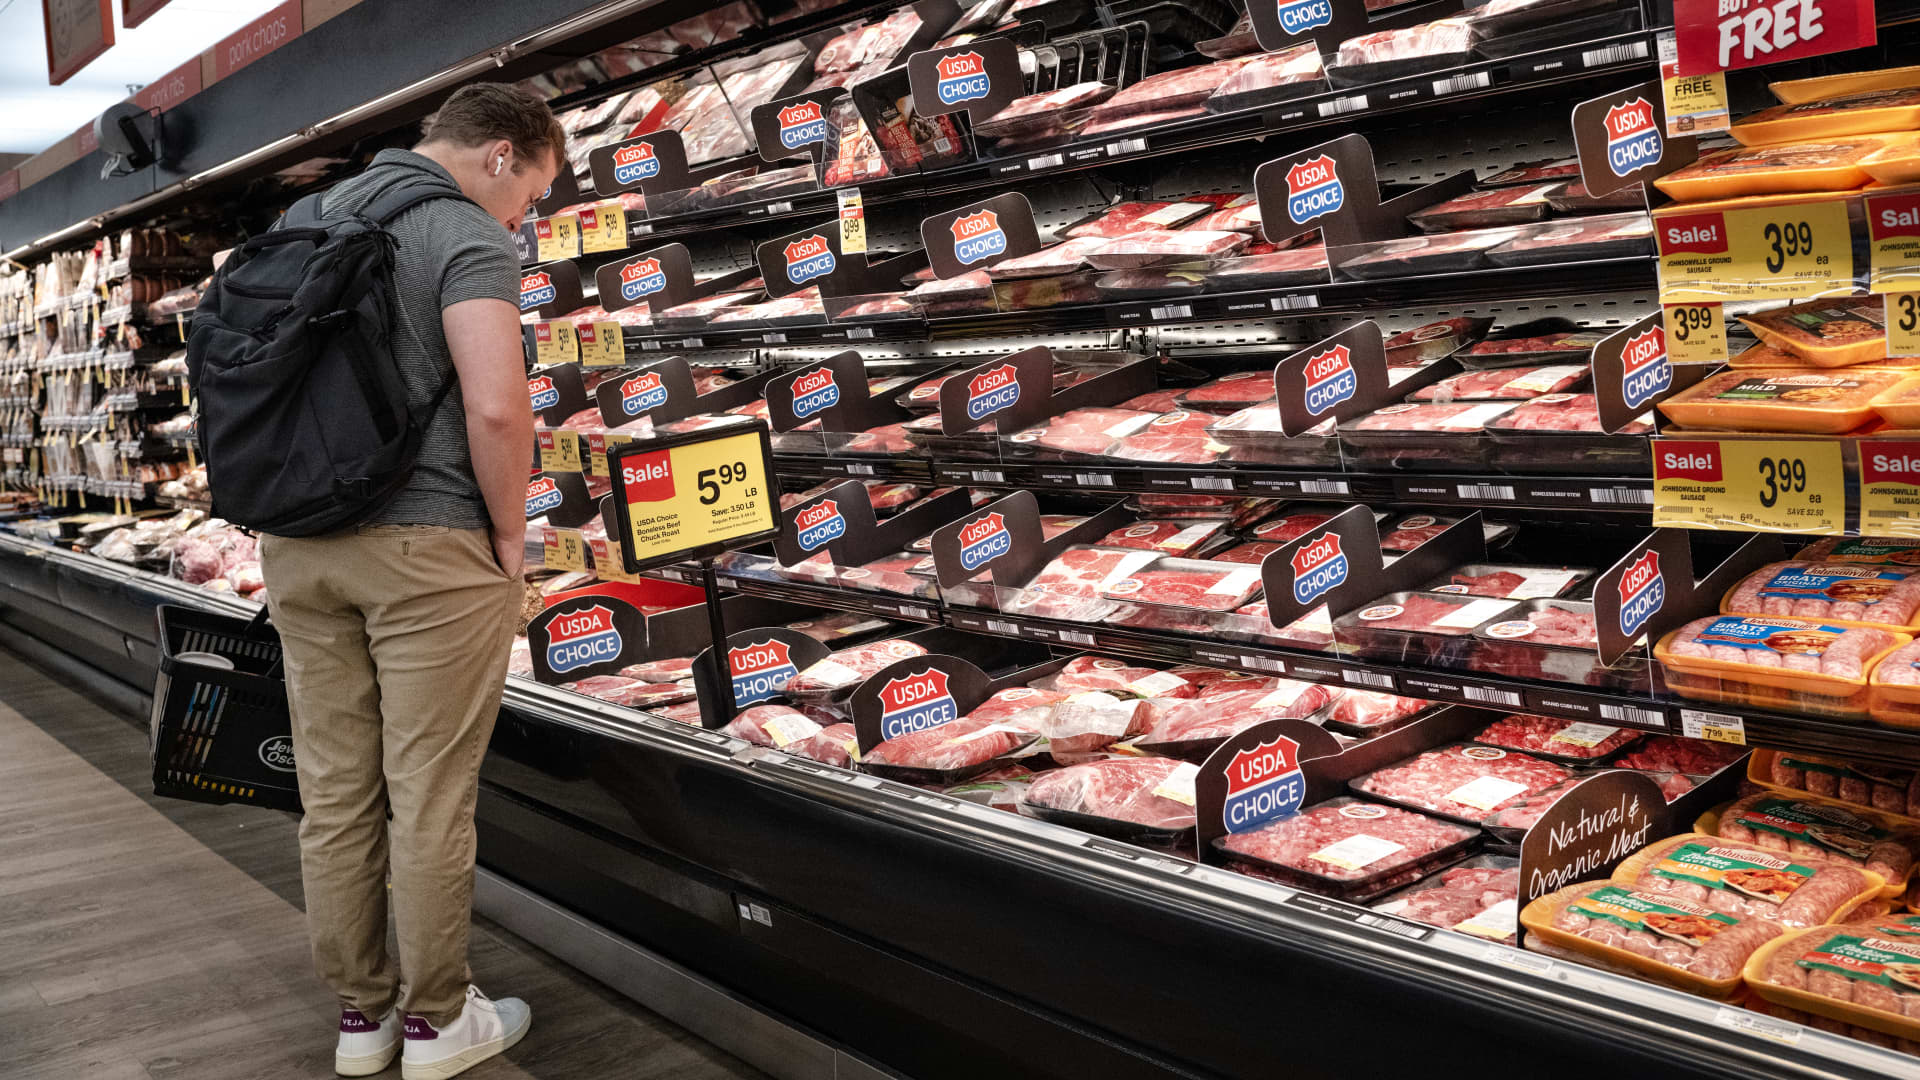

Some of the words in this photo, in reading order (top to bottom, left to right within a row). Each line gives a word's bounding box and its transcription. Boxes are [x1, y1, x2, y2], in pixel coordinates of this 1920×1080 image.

[1284, 2, 1329, 26] CHOICE
[228, 38, 252, 70] pork
[252, 16, 287, 51] chops
[1718, 0, 1824, 67] FREE
[946, 59, 976, 75] USDA
[943, 79, 987, 98] CHOICE
[1675, 80, 1712, 96] FREE
[786, 108, 815, 123] USDA
[1614, 109, 1646, 133] USDA
[785, 123, 825, 145] CHOICE
[621, 148, 647, 162] USDA
[1613, 137, 1659, 167] CHOICE
[618, 162, 657, 180] CHOICE
[1296, 164, 1328, 186] USDA
[1293, 191, 1340, 216] CHOICE
[605, 213, 617, 239] 599
[843, 219, 859, 240] 999
[959, 218, 992, 237] USDA
[793, 242, 821, 258] USDA
[959, 238, 1003, 260] CHOICE
[1667, 225, 1717, 244] Sale!
[1764, 221, 1813, 274] 399
[792, 258, 832, 279] CHOICE
[1667, 258, 1707, 267] JOHNSONVILLE
[1708, 256, 1732, 265] GROUND
[1816, 255, 1828, 265] ea
[628, 264, 654, 278] USDA
[1686, 266, 1712, 274] SAUSAGE
[1794, 271, 1813, 279] SAVE
[626, 277, 663, 296] CHOICE
[1673, 307, 1712, 341] 399
[558, 328, 569, 351] 599
[1630, 337, 1659, 364] USDA
[1313, 354, 1342, 378] USDA
[528, 380, 547, 393] SDA
[629, 378, 655, 393] USDA
[800, 374, 826, 392] USDA
[978, 372, 1008, 391] USDA
[1627, 363, 1670, 399] CHOICE
[531, 392, 556, 408] OICE
[627, 391, 665, 410] CHOICE
[797, 392, 837, 412] CHOICE
[972, 390, 1017, 414] CHOICE
[1309, 381, 1353, 408] CHOICE
[622, 459, 669, 485] Sale!
[697, 461, 747, 506] 599
[1661, 485, 1701, 493] JOHNSONVILLE
[1702, 486, 1726, 494] GROUND
[1664, 452, 1713, 470] Sale!
[1759, 457, 1806, 508] 399
[745, 487, 758, 498] LB
[1808, 494, 1821, 503] ea
[1869, 487, 1918, 496] JOHNSONVILLE
[711, 508, 730, 517] Save:
[730, 504, 745, 513] 3.50
[745, 501, 755, 510] LB
[804, 506, 831, 525] USDA
[1787, 508, 1806, 516] SAVE
[1807, 508, 1824, 517] $2.50
[637, 516, 656, 527] USDA
[656, 513, 679, 523] Choice
[637, 525, 666, 536] Boneless
[667, 521, 681, 531] Beef
[640, 533, 661, 543] Chuck
[662, 529, 680, 539] Roast
[802, 523, 843, 545] CHOICE
[968, 520, 997, 541] USDA
[966, 538, 1008, 564] CHOICE
[1301, 542, 1333, 568] USDA
[1299, 564, 1345, 597] CHOICE
[1627, 562, 1652, 592] USDA
[1807, 567, 1878, 578] Johnsonville
[1624, 587, 1662, 627] CHOICE
[560, 615, 602, 636] USDA
[1711, 628, 1761, 636] ORIGINAL
[1714, 622, 1768, 632] BRATS
[1748, 618, 1817, 630] Johnsonville
[554, 640, 617, 664] CHOICE
[735, 649, 779, 671] USDA
[894, 679, 937, 704] USDA
[888, 704, 952, 737] CHOICE
[1705, 727, 1722, 738] 799
[1241, 750, 1286, 782] USDA
[1231, 782, 1299, 824] CHOICE
[1548, 793, 1626, 856] Natural
[1628, 794, 1639, 824] &
[1764, 814, 1793, 825] HOT
[1529, 849, 1600, 900] Organic
[1603, 814, 1652, 865] Meat
[1683, 853, 1732, 866] Italian
[1710, 847, 1785, 869] Johnsonville
[1678, 862, 1710, 873] MILD
[1596, 903, 1629, 913] MILD
[1634, 892, 1709, 916] Johnsonville
[1831, 954, 1865, 966] HOT
[342, 1018, 364, 1026] VEJA
